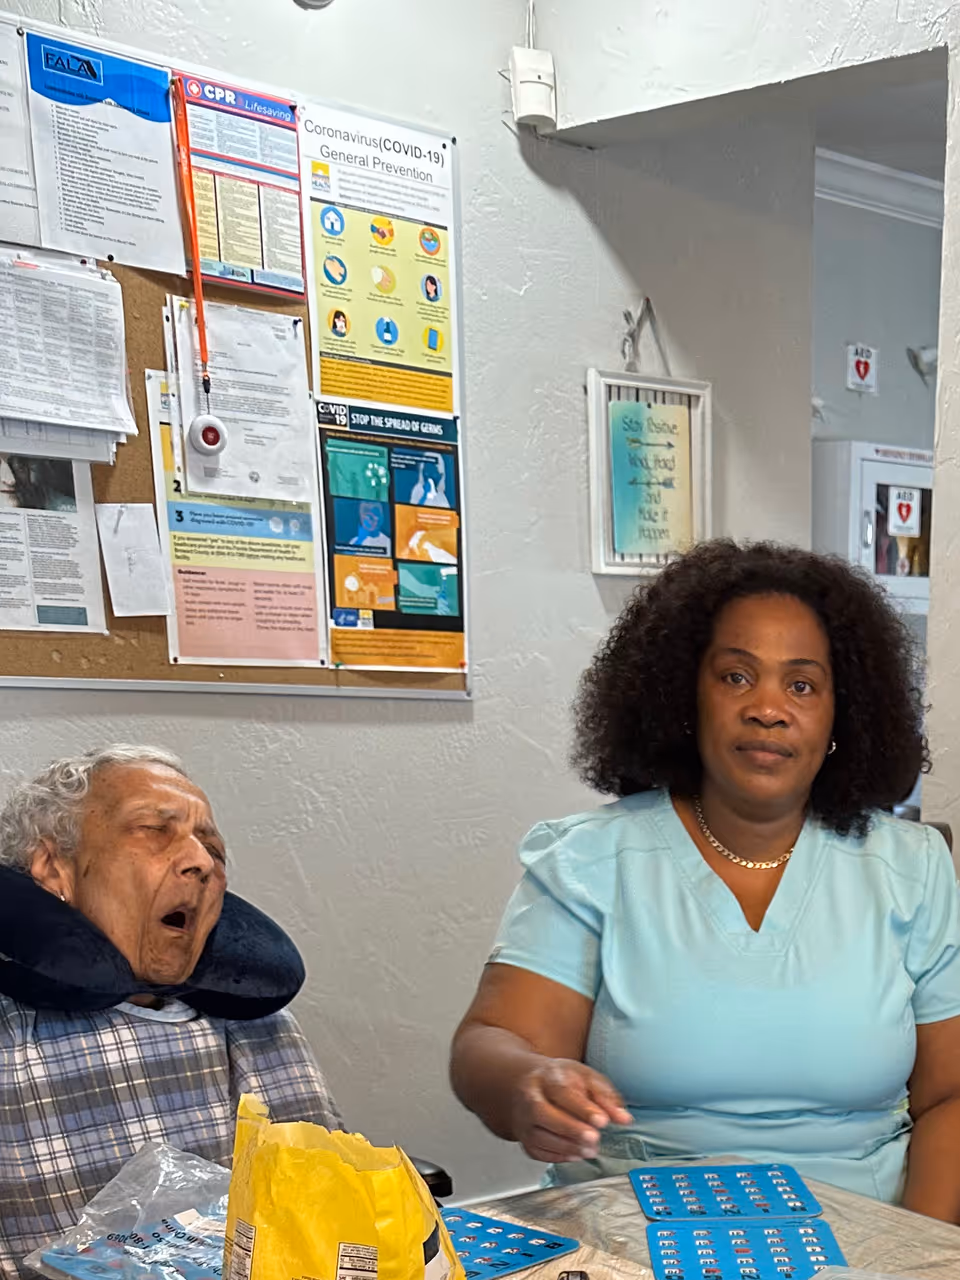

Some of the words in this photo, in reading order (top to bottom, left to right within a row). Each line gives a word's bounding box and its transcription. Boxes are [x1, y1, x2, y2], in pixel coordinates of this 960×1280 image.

[44, 52, 97, 79] FALA
[203, 84, 236, 105] CPR
[245, 100, 292, 121] Lifesaving
[304, 119, 445, 168] Coronavirus(COVID-19)
[320, 144, 369, 167] General
[372, 156, 433, 183] Prevention
[854, 347, 872, 359] AED
[318, 403, 346, 415] COVID
[334, 415, 347, 425] 19
[351, 413, 368, 424] STOP
[370, 415, 383, 427] THE
[384, 417, 410, 430] SPREAD
[411, 420, 420, 431] OF
[420, 422, 443, 435] GERMS
[173, 480, 181, 493] 2
[896, 491, 914, 502] AED
[175, 510, 184, 523] 3
